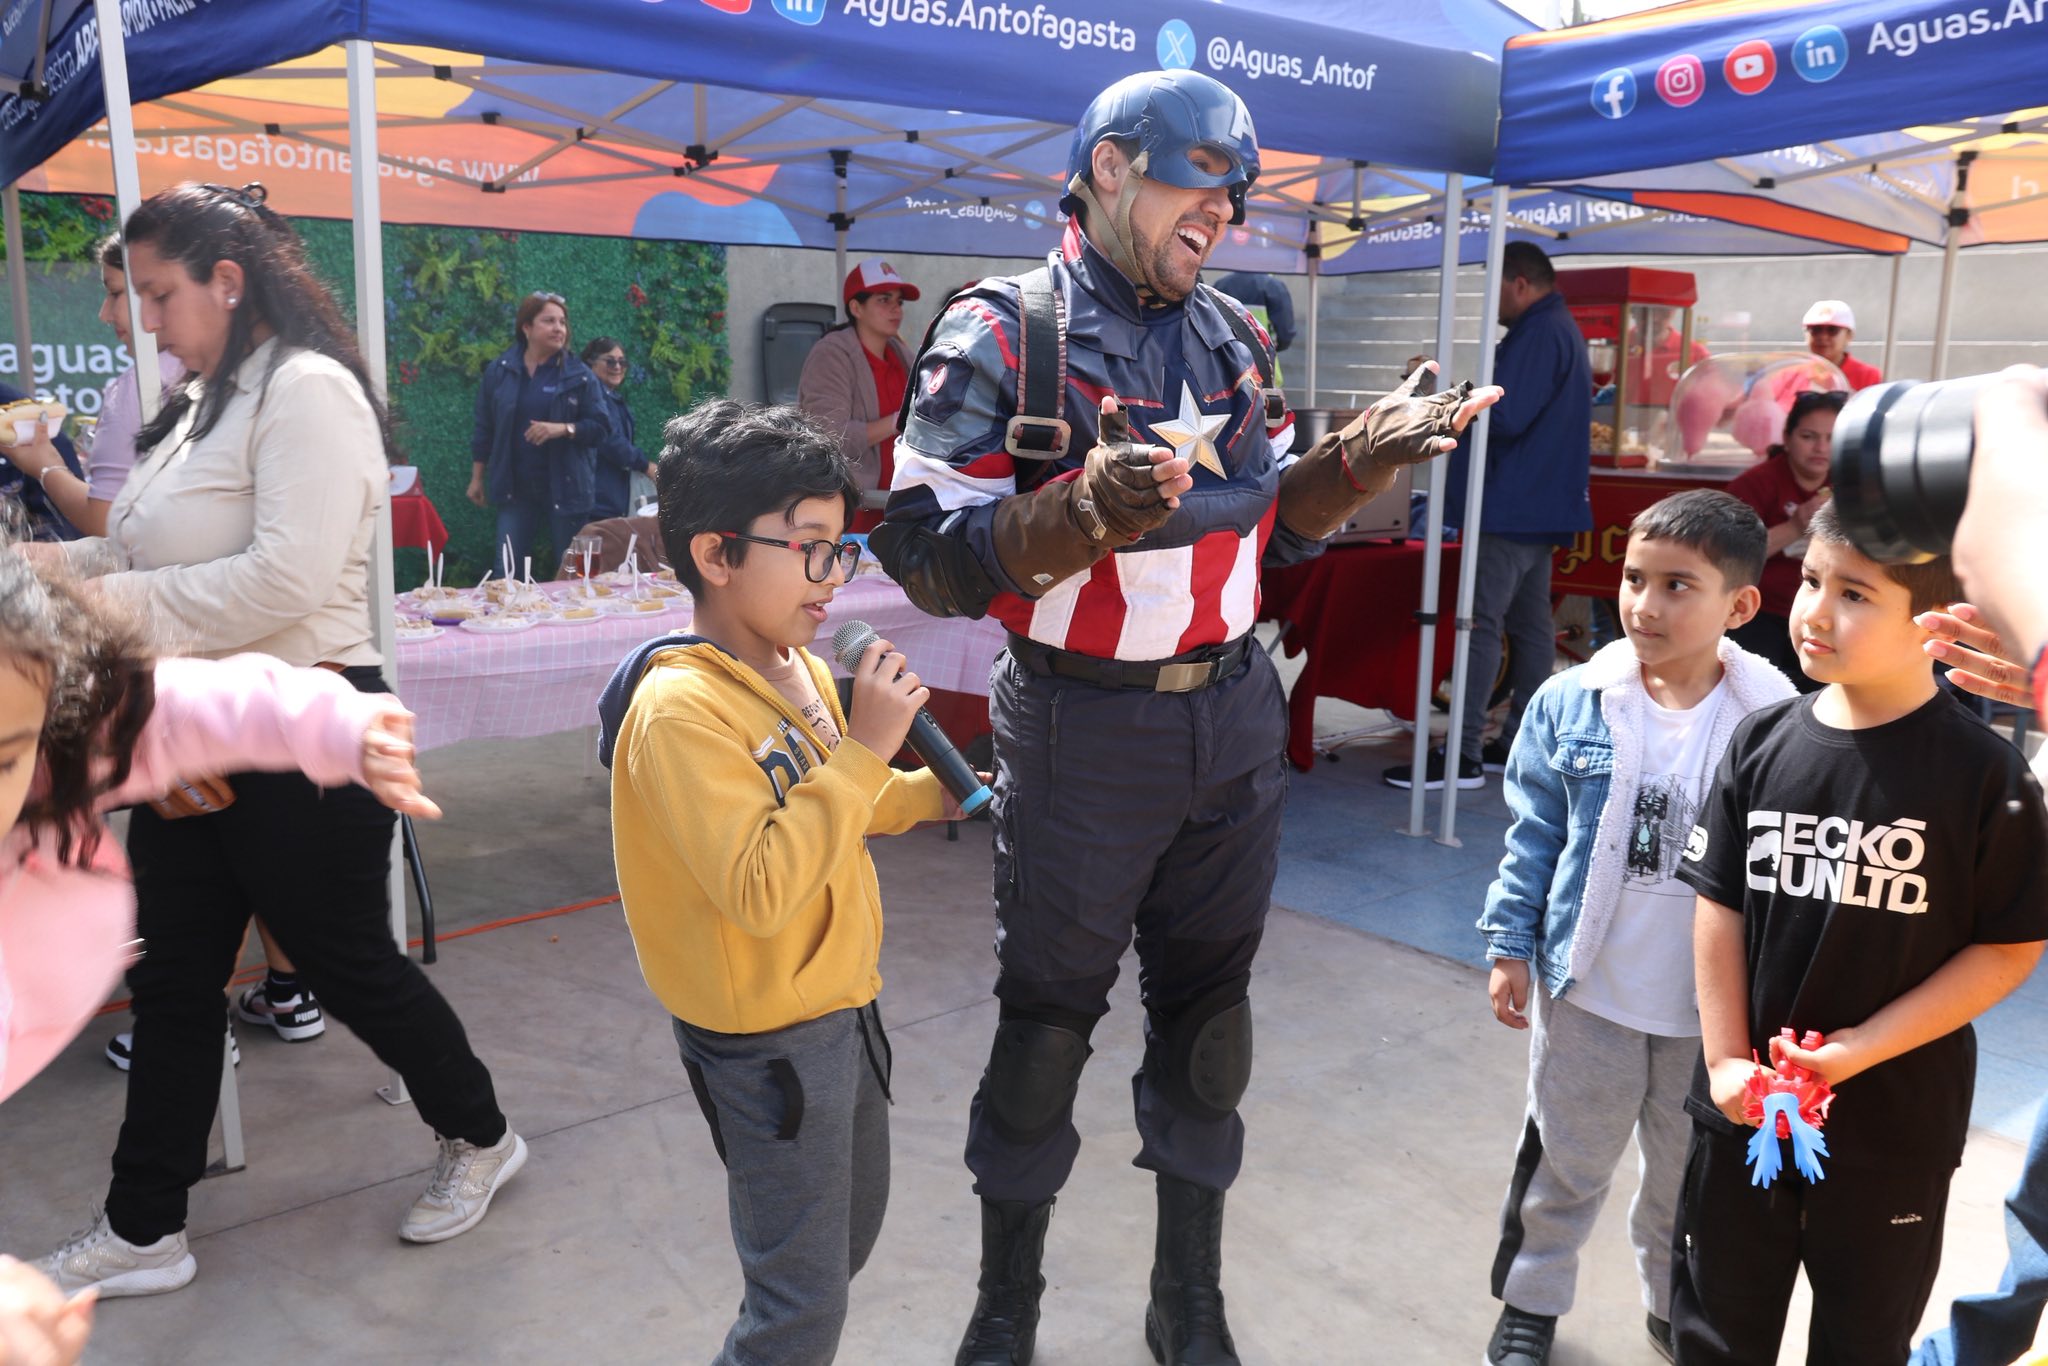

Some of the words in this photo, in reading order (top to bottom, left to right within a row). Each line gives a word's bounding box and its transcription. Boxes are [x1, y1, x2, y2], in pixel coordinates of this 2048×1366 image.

[844, 0, 1136, 51] Aguas.Antofagasta
[1207, 36, 1378, 91] @Aguas_Antof
[0, 342, 135, 384] aguas
